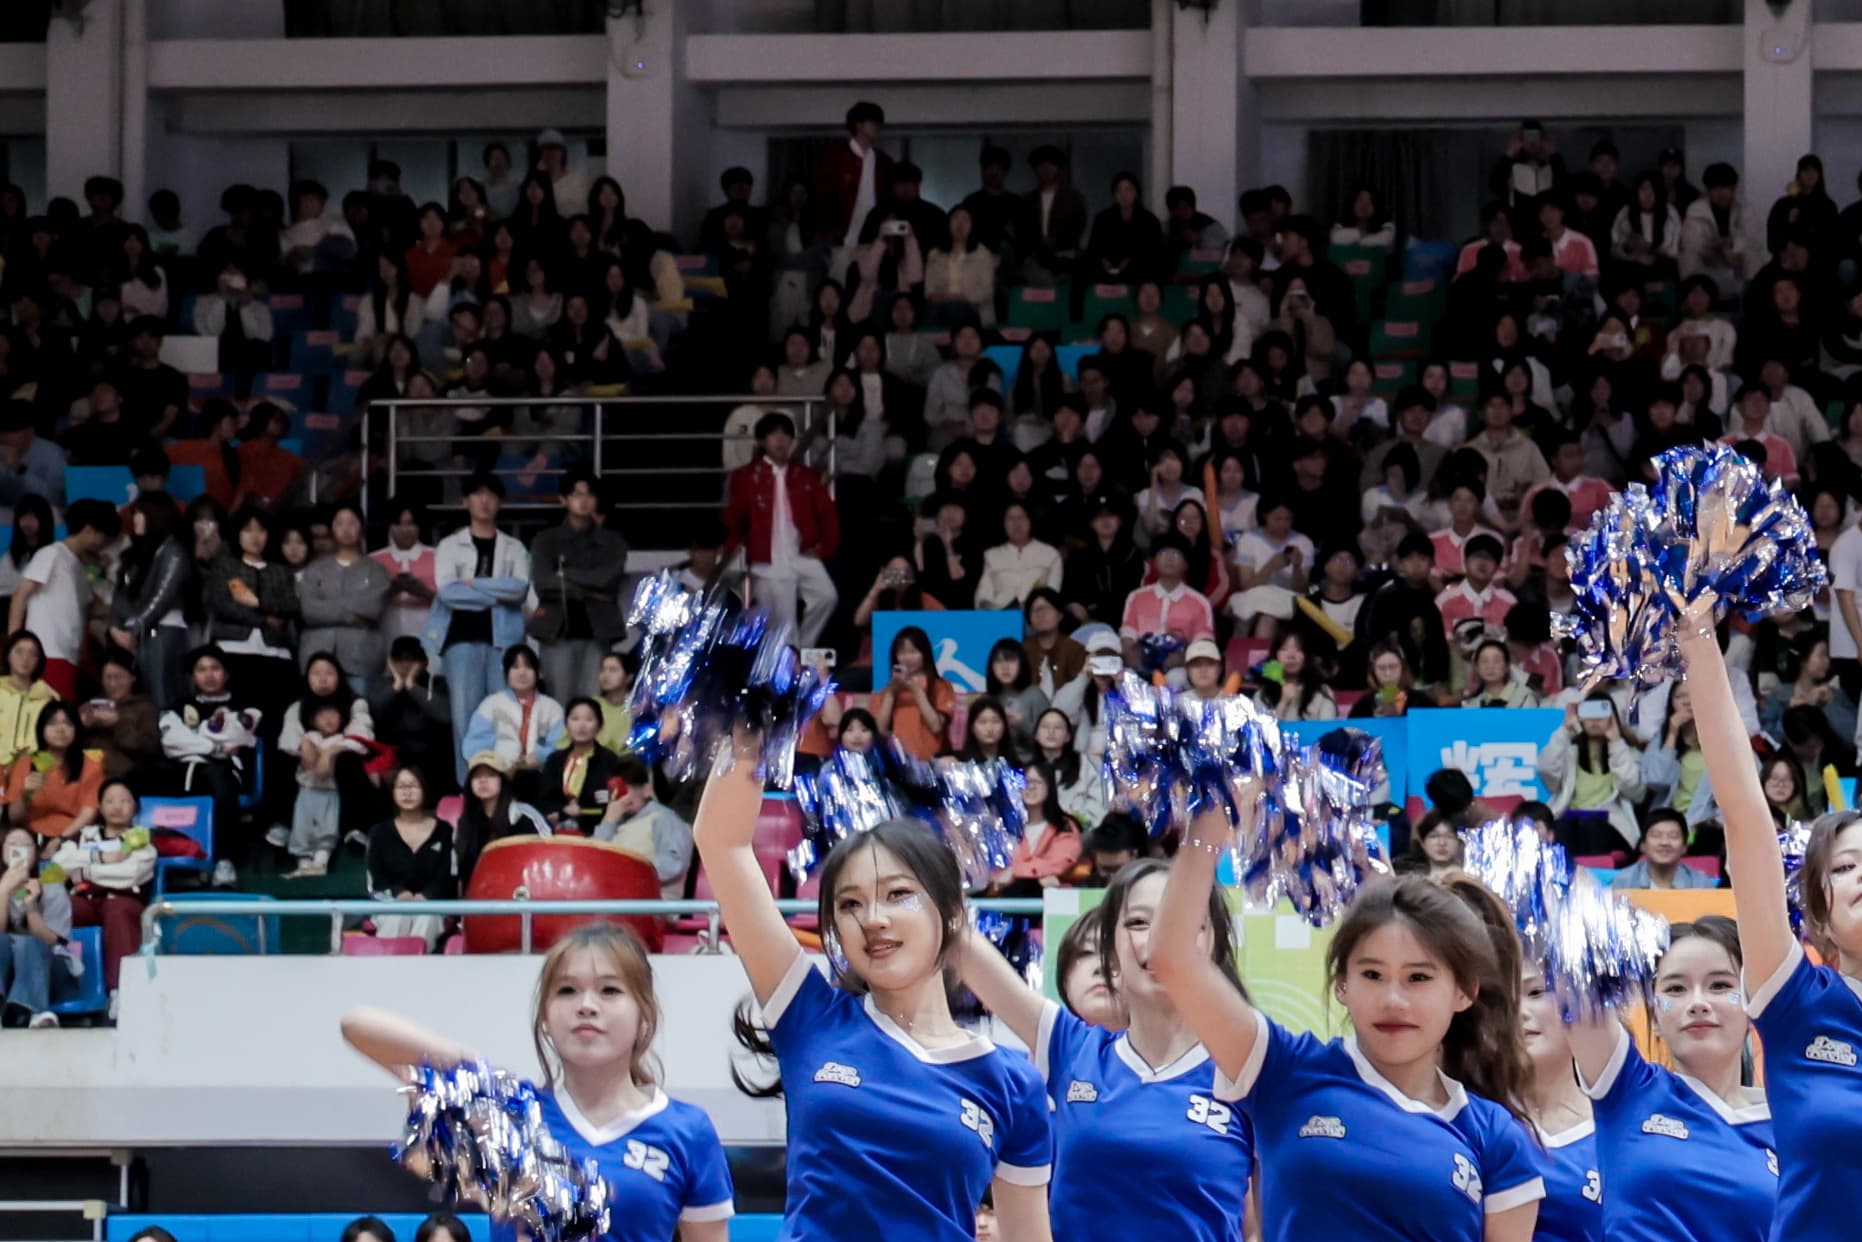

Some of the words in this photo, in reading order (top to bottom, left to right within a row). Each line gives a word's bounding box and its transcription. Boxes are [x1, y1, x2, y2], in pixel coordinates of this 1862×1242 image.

[960, 1098, 994, 1148] 32
[1186, 1094, 1232, 1136] 32
[623, 1139, 670, 1182] 32
[1452, 1152, 1483, 1204] 32
[1582, 1169, 1601, 1201] 3
